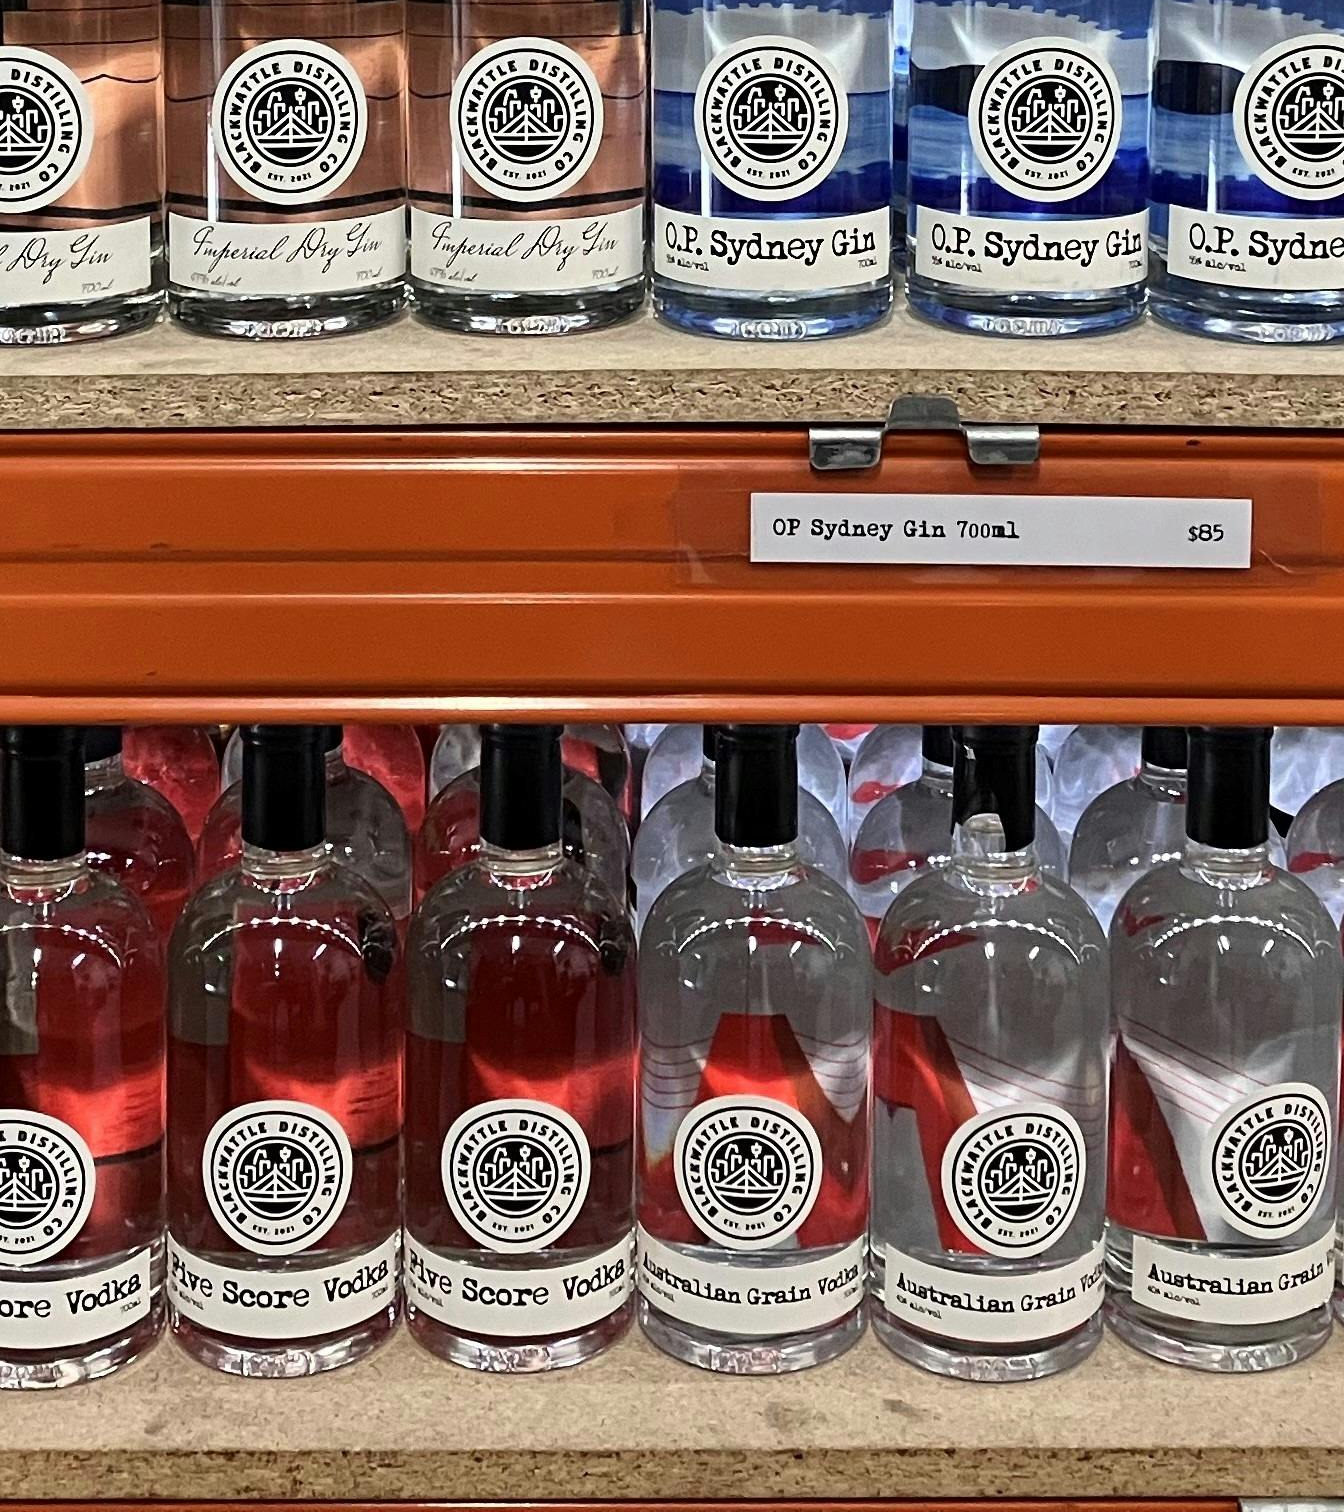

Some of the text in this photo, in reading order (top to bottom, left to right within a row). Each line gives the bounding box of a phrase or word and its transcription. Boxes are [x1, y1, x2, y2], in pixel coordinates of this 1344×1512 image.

[1254, 56, 1312, 168] BLACKWATTLE
[6, 238, 64, 285] Dry
[70, 234, 110, 269] Gin
[194, 223, 383, 273] Imperial Dry Gin
[432, 222, 619, 271] Imperial Dry Gin
[666, 222, 702, 255] O.P.
[710, 230, 824, 266] Sydney
[832, 228, 875, 256] Gin
[932, 224, 975, 257] O.P.
[984, 231, 1099, 267] Sydney
[1106, 229, 1141, 257] Gin
[1190, 223, 1239, 256] O.P.
[773, 518, 1019, 544] OP Sydney Gin 700ml
[1188, 524, 1225, 543] $85
[65, 1273, 142, 1316] Vodka
[223, 1281, 311, 1309] Score
[323, 1260, 389, 1302] Vodka
[462, 1258, 625, 1306] Score Vodka
[748, 1286, 811, 1306] Grain
[897, 1272, 1076, 1314] Australian Grain
[1147, 1263, 1273, 1296] Australian
[1278, 1262, 1324, 1290] Grain
